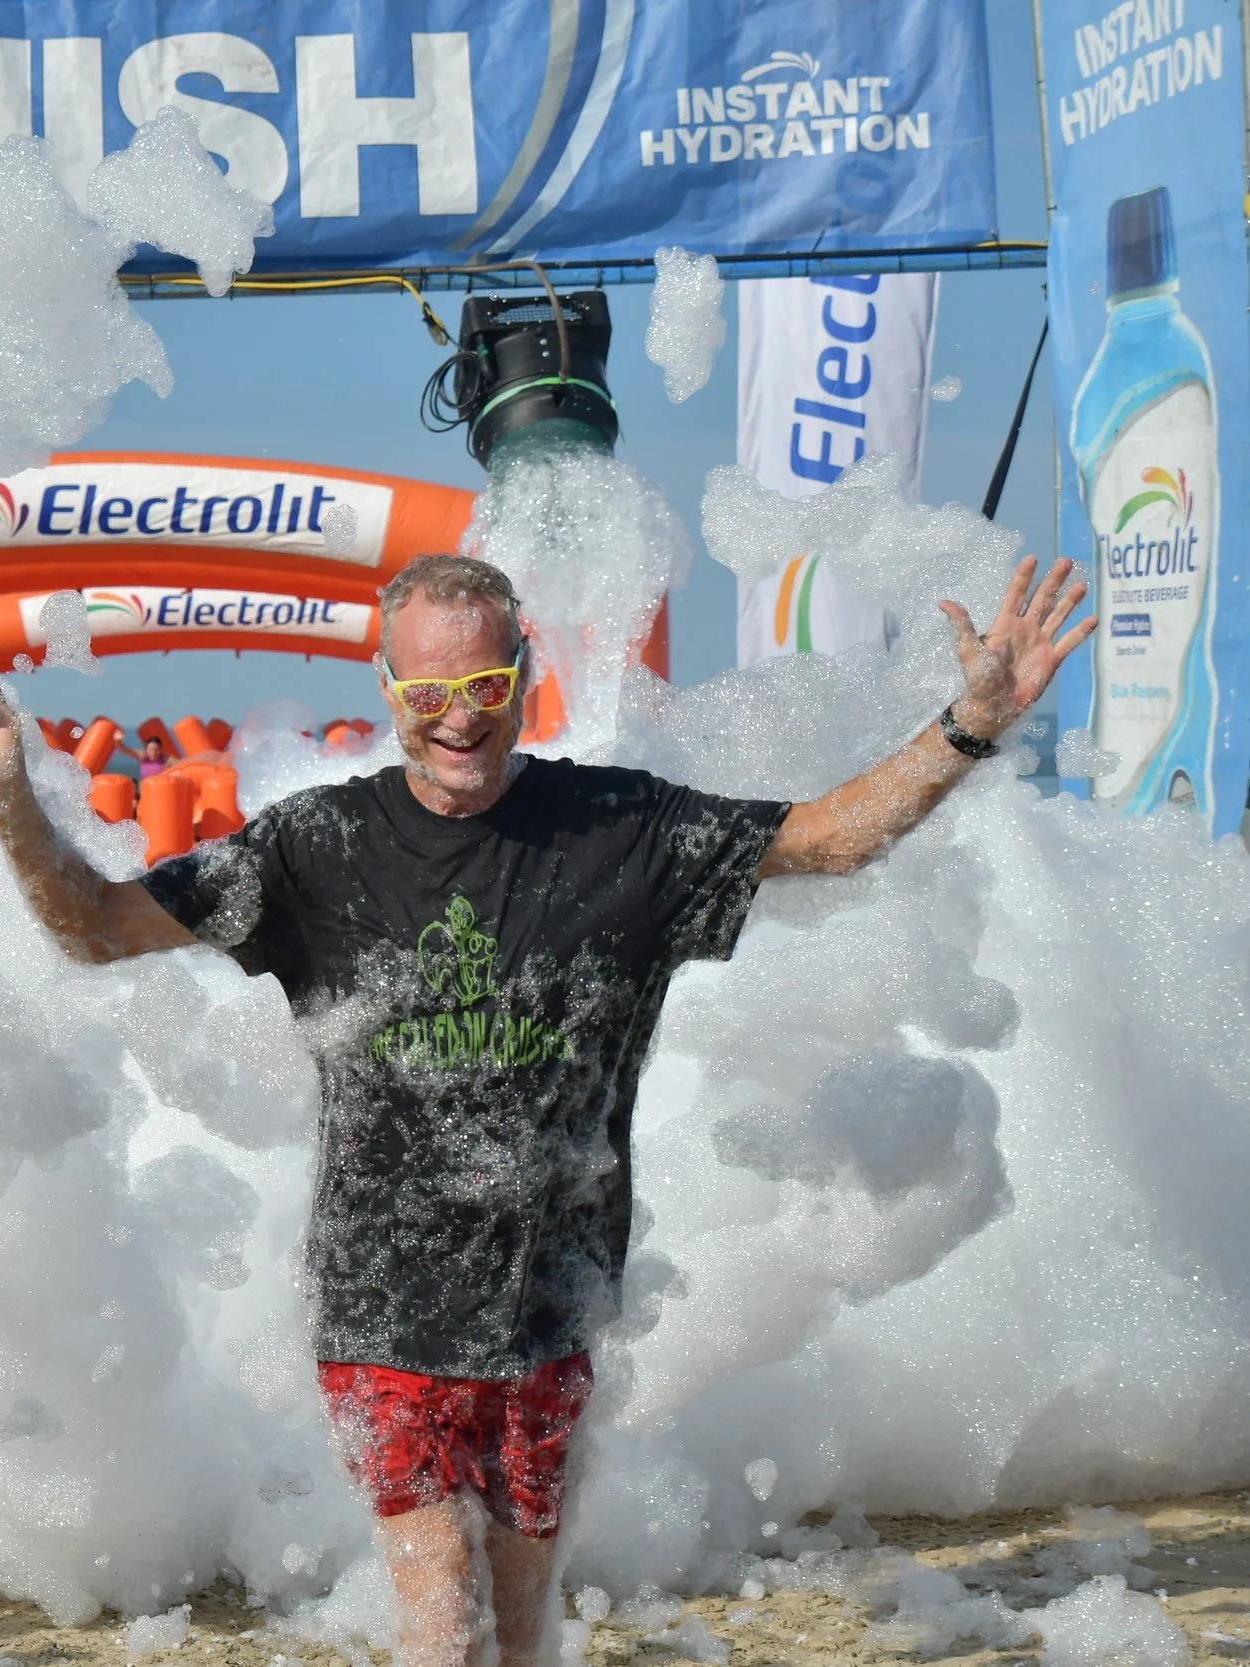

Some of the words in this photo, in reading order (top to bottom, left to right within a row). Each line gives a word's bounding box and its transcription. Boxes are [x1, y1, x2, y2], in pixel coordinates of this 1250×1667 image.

[676, 76, 891, 125] INSTANT
[1060, 24, 1223, 146] HYDRATION
[639, 112, 930, 166] HYDRATION
[37, 483, 336, 536] Electrolit
[1099, 526, 1198, 579] lectrolit
[156, 593, 337, 626] Electrolit
